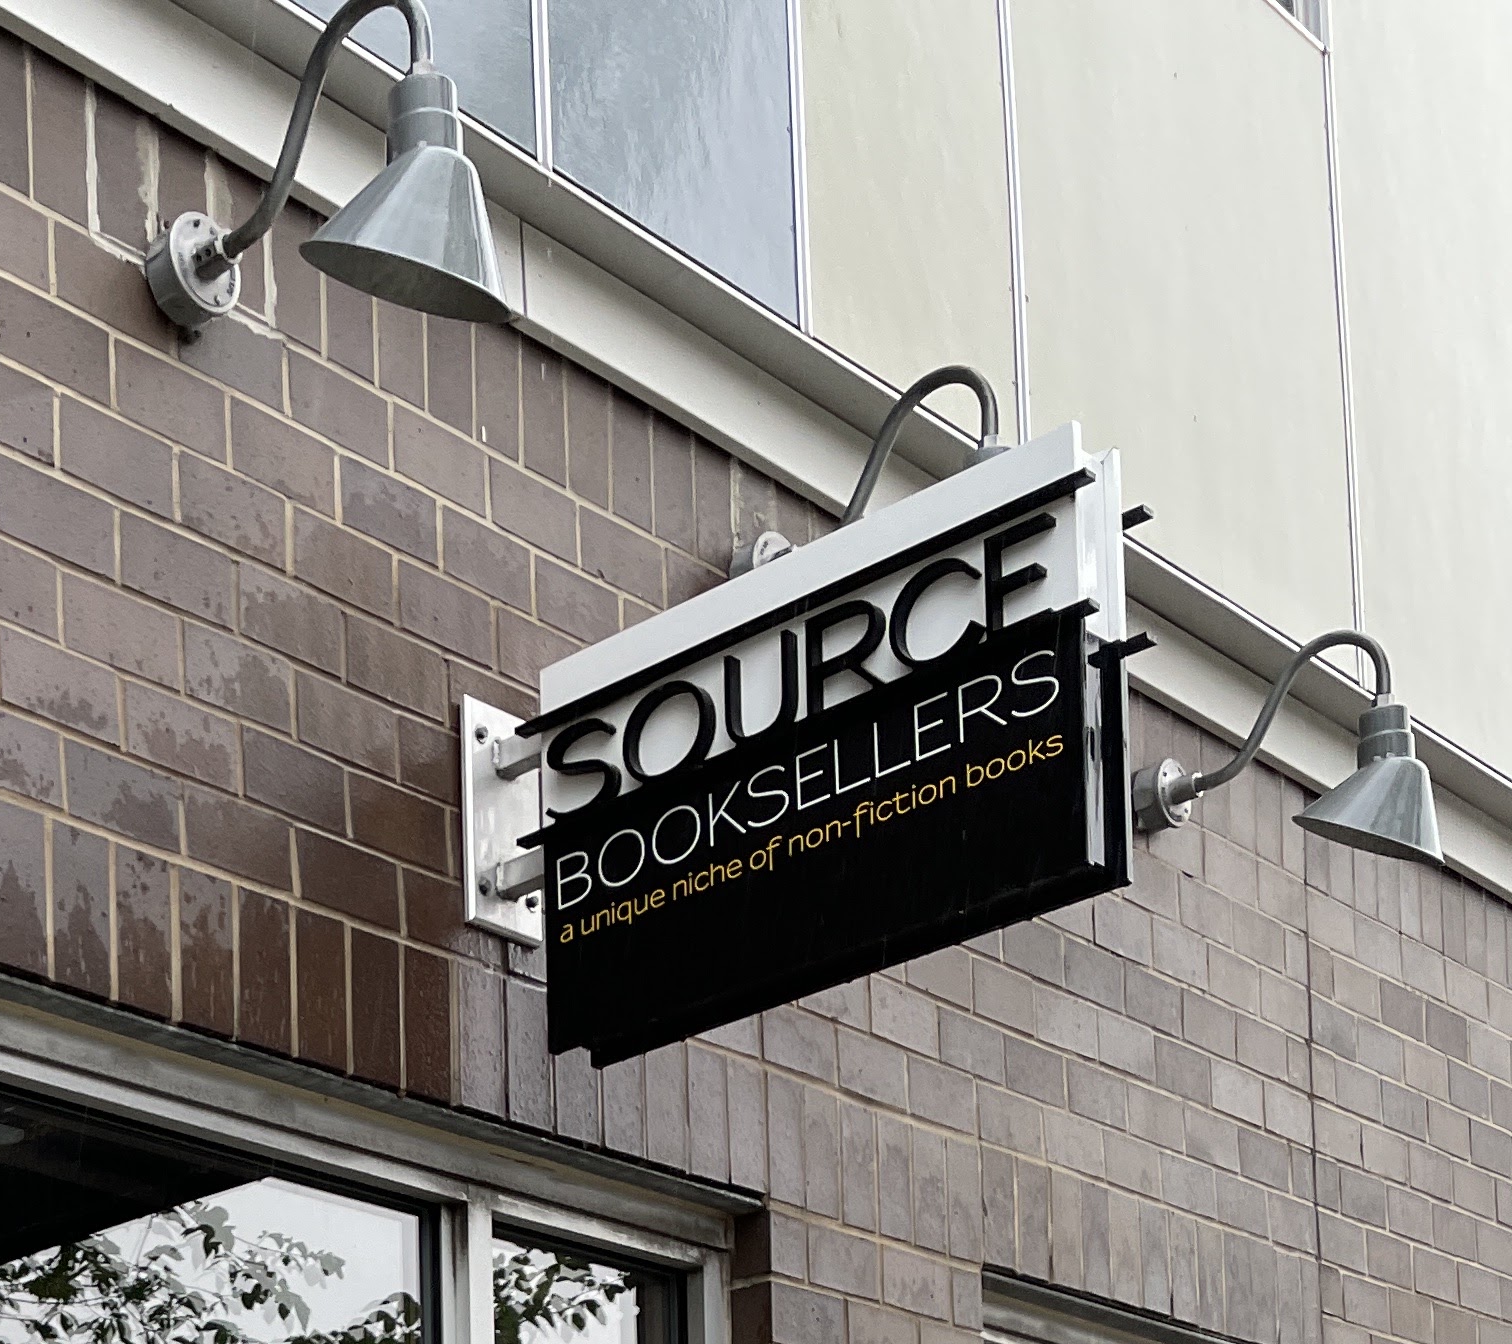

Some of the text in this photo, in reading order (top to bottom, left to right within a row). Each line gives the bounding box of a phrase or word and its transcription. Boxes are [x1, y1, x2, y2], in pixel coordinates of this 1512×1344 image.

[545, 511, 1056, 819] SOURCE
[555, 649, 1062, 910] BOOKSELLERS
[559, 734, 1065, 944] a unique niche of non-fiction books
